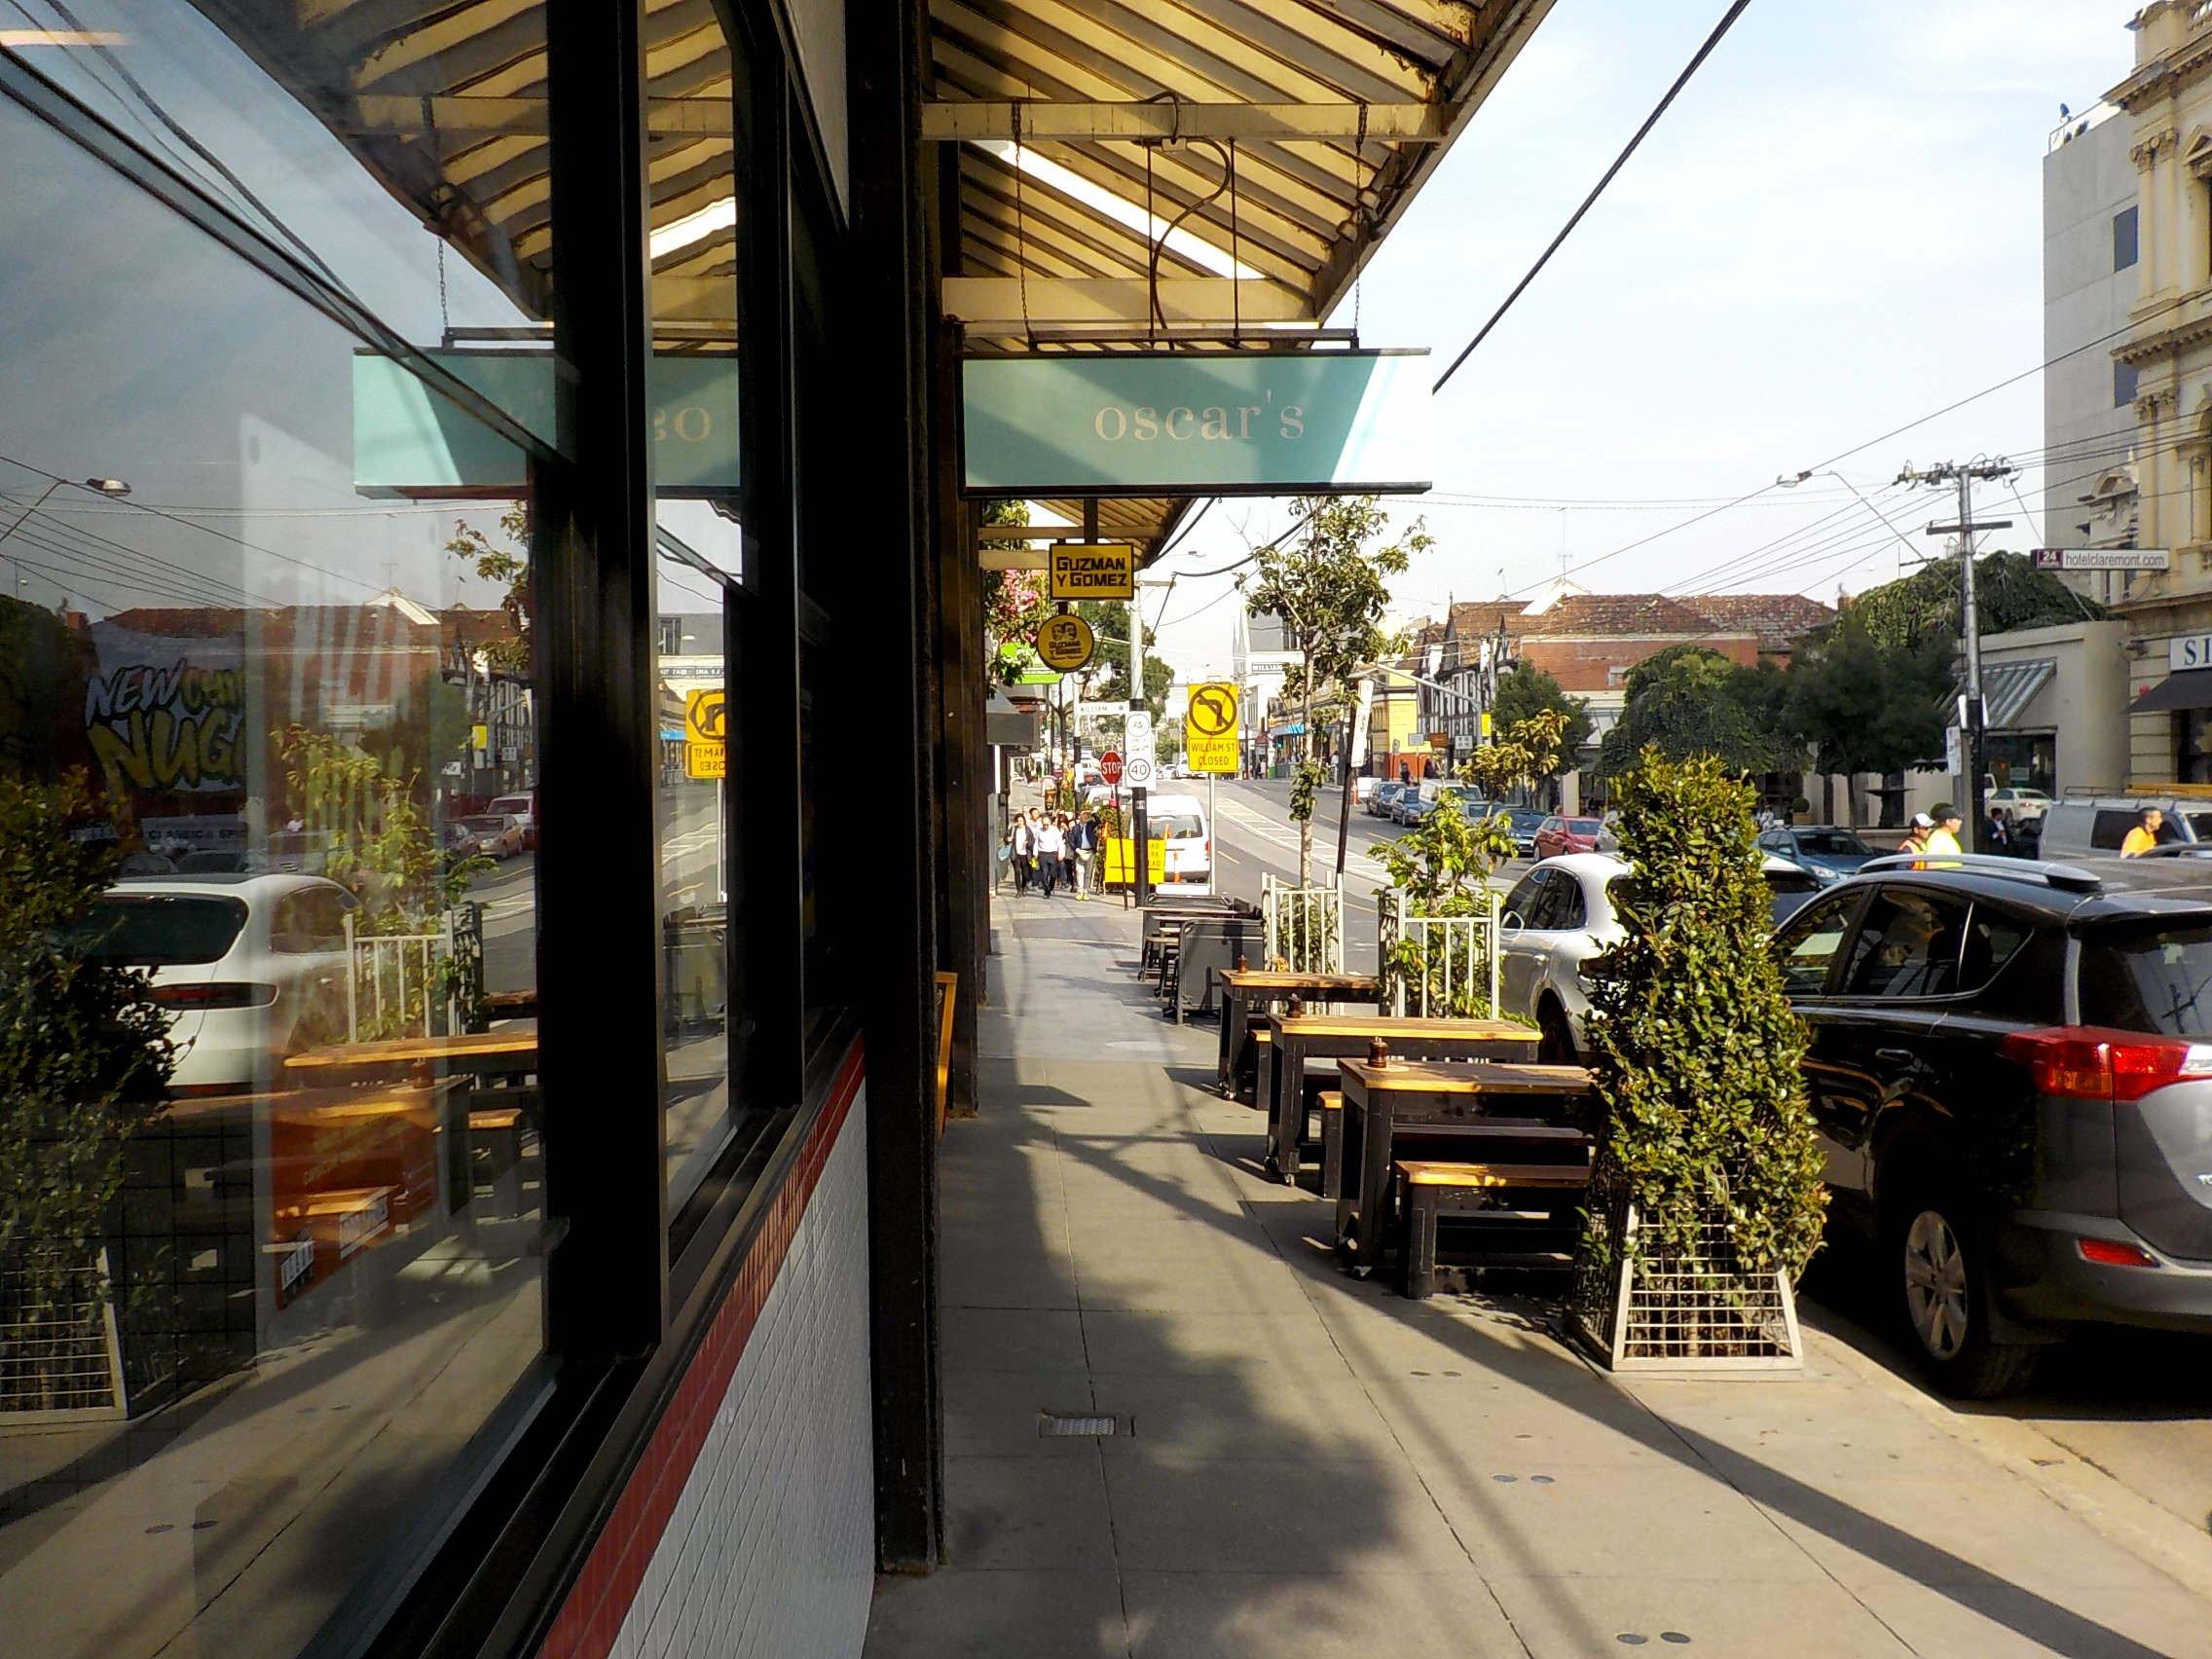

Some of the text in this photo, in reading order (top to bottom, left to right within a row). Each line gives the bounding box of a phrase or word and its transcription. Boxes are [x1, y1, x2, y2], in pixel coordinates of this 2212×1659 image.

[1094, 389, 1306, 441] oscar's
[1056, 556, 1124, 571] GUZMAN
[2043, 550, 2165, 567] 24 hotelclaremont.com
[1055, 571, 1127, 587] Y GOMEZ
[86, 657, 186, 726] NEW
[1191, 742, 1235, 753] WILLIAM ST
[1101, 761, 1122, 775] STOP
[1198, 756, 1230, 766] CLOSED
[1130, 764, 1147, 776] 40
